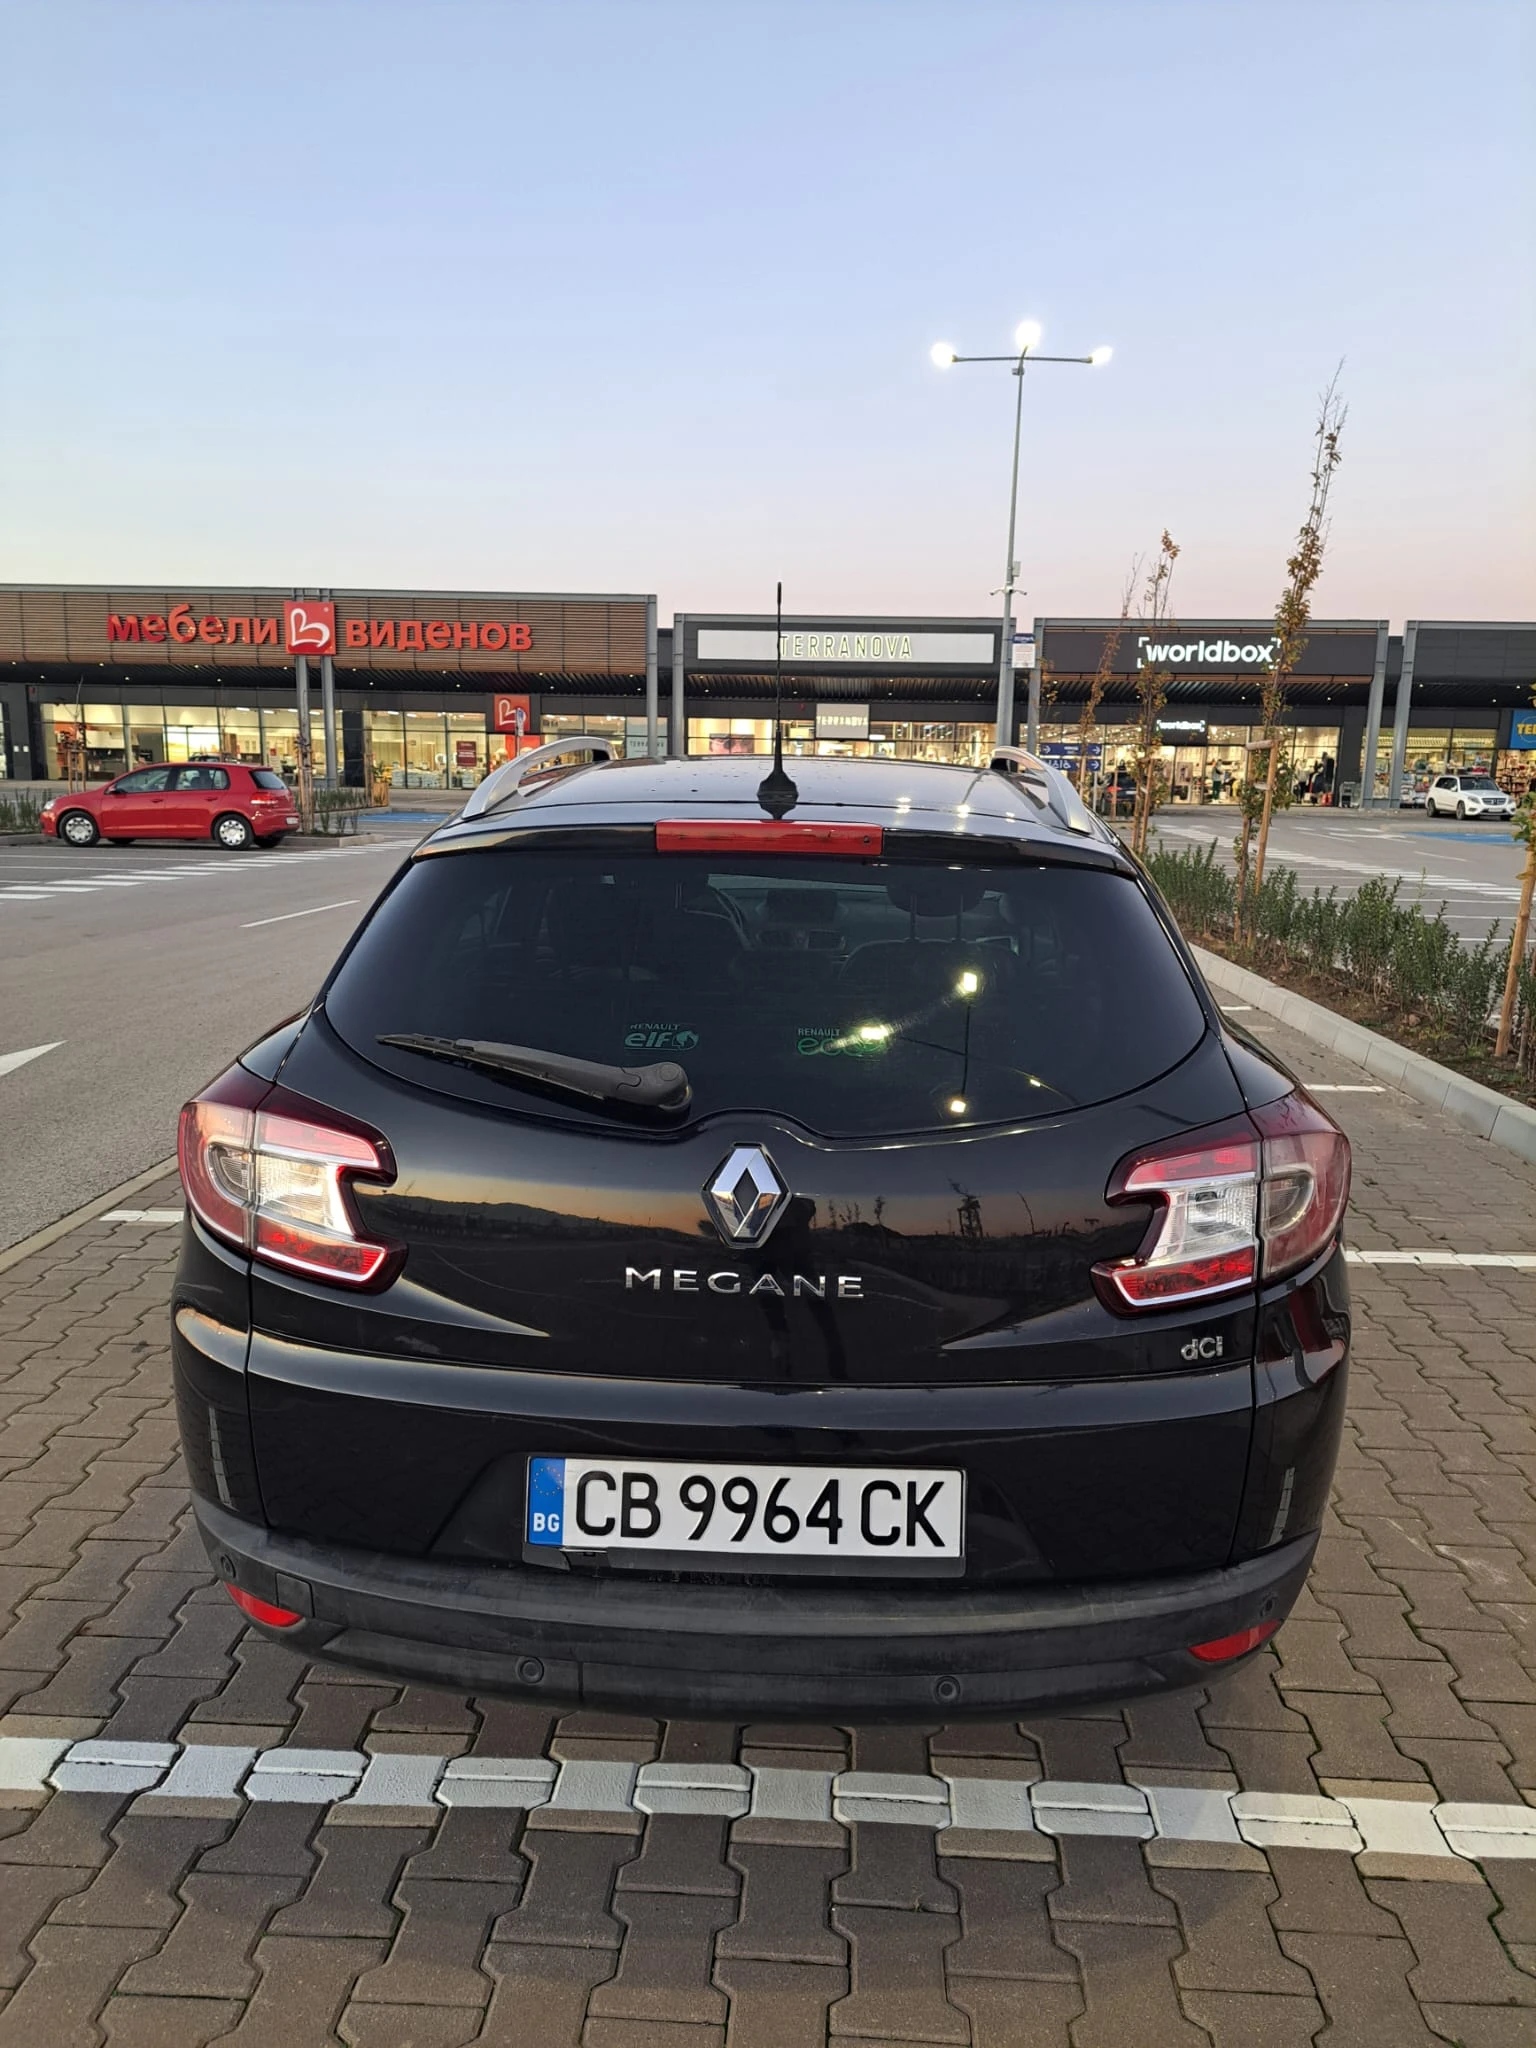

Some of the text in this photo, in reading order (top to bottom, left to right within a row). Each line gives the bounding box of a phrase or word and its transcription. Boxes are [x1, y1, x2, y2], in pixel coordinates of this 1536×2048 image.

[107, 603, 533, 651] мебели виденов
[780, 633, 912, 659] TERRANOVA
[1145, 640, 1274, 663] worldbox
[1516, 723, 1536, 736] TE
[630, 1023, 680, 1031] RENAULT
[798, 1027, 841, 1037] RENAULT
[624, 1031, 673, 1048] elf
[625, 1266, 864, 1298] MEGANE
[1180, 1335, 1223, 1361] dCi
[575, 1470, 946, 1548] CB 9964 CK
[533, 1512, 560, 1533] BG
